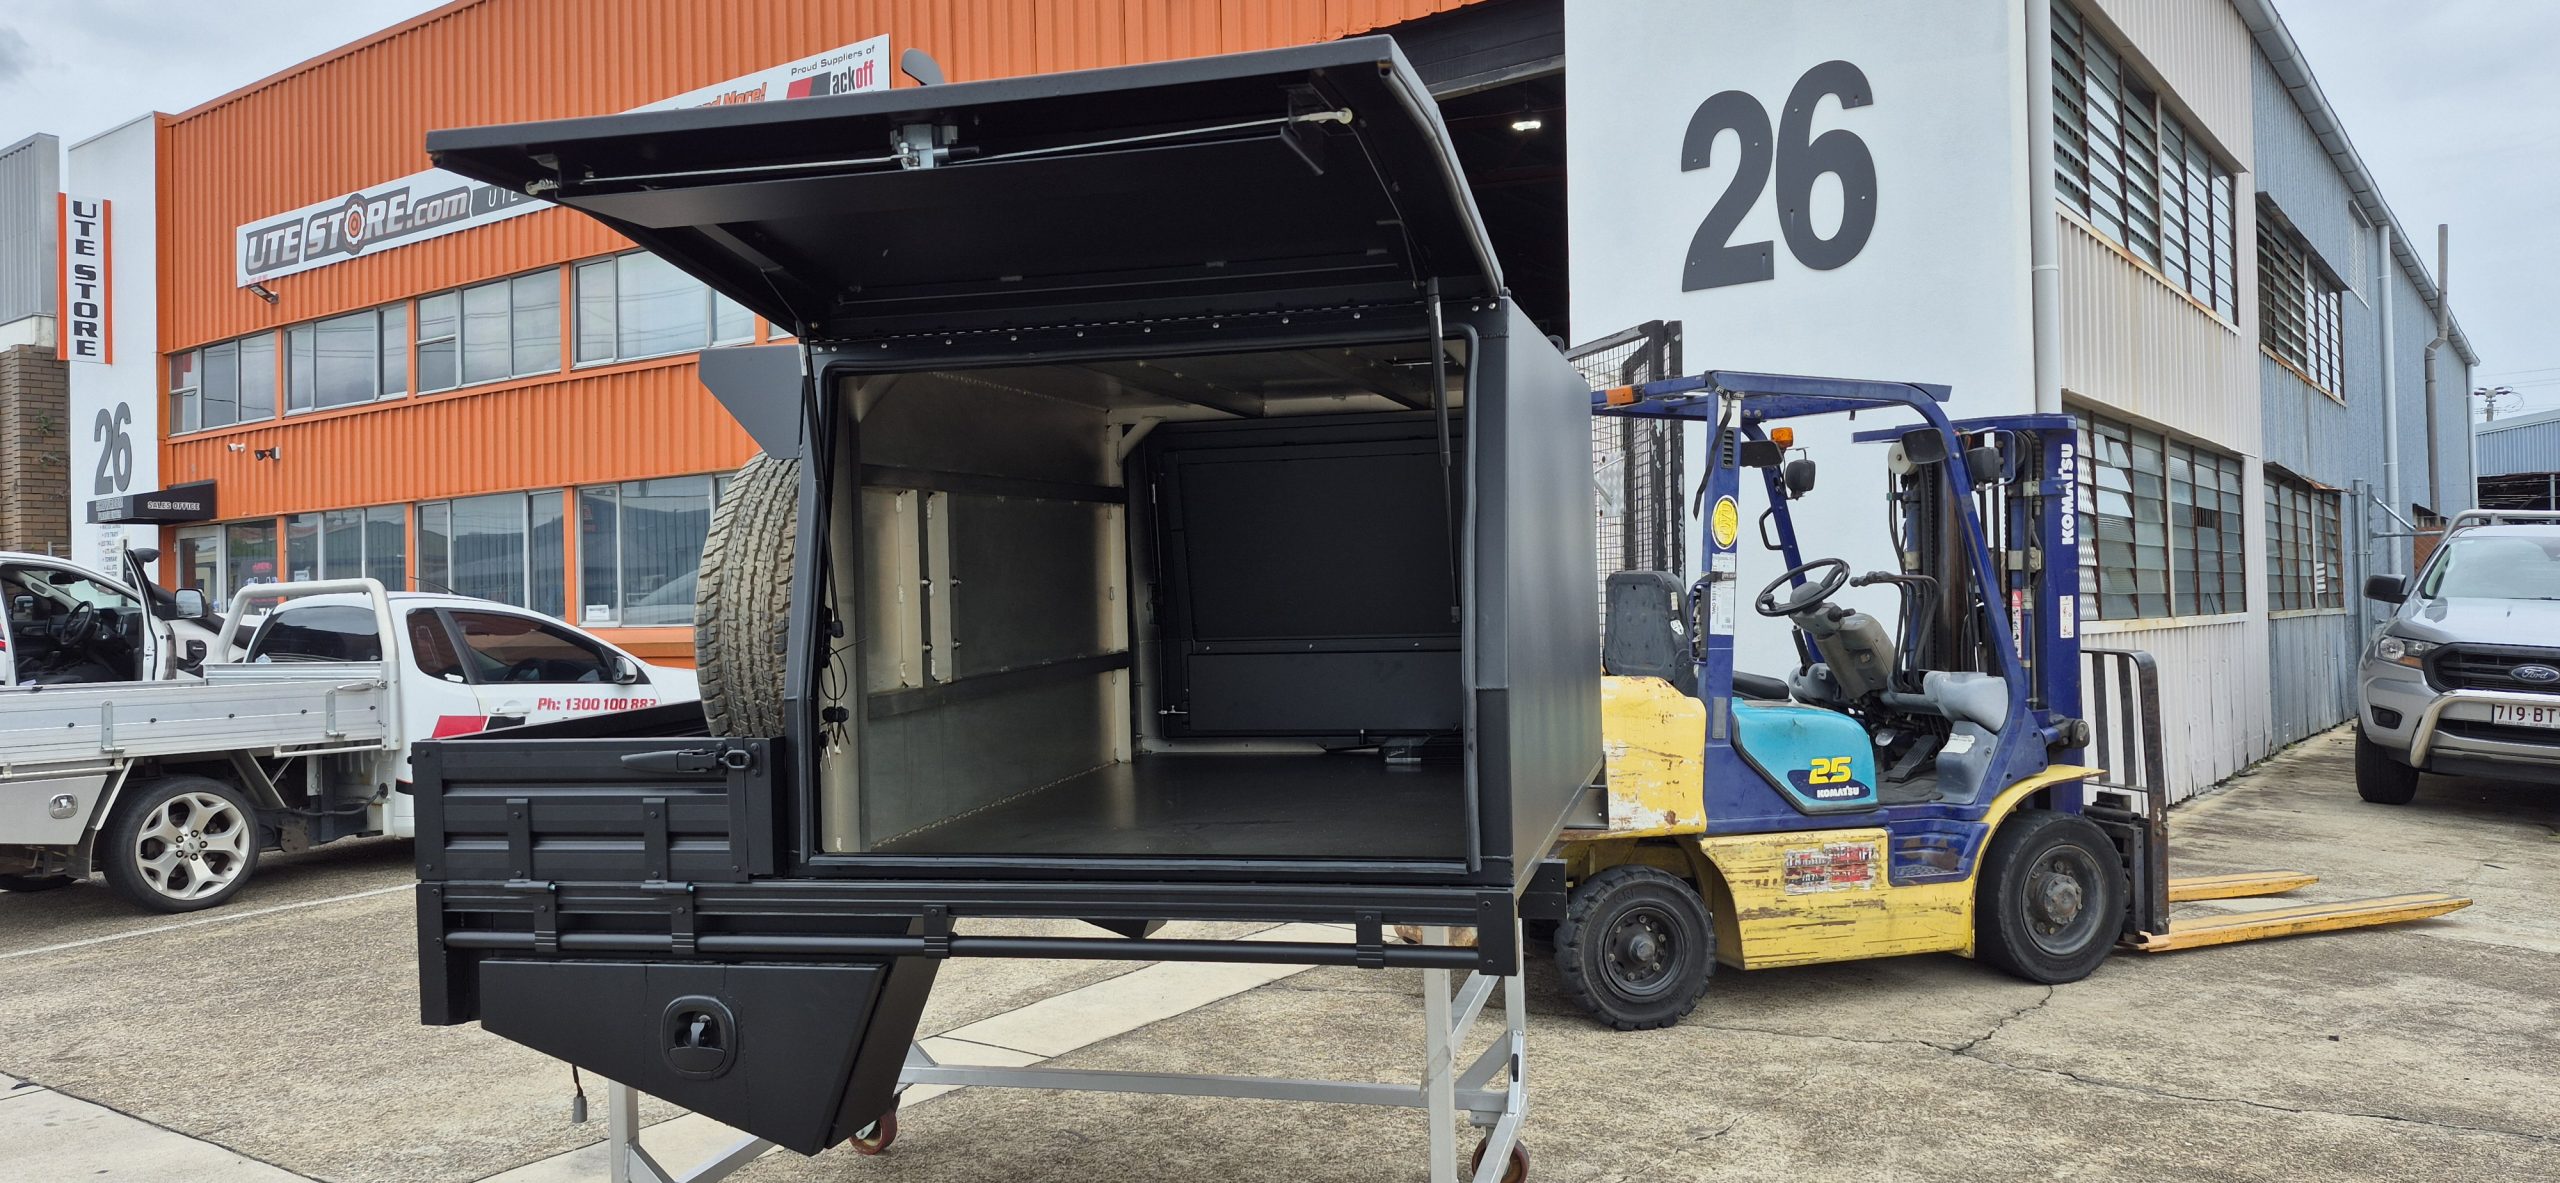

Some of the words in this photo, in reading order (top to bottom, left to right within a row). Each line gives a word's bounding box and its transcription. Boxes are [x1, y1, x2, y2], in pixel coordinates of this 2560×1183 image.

[791, 62, 818, 76] Proud
[821, 50, 863, 67] Suppliers
[866, 44, 875, 55] of
[1681, 60, 1877, 292] 26
[73, 200, 97, 256] UTE
[248, 224, 300, 270] UTE
[74, 264, 98, 356] STORE
[94, 402, 132, 495] 26
[147, 500, 172, 510] SALES
[172, 501, 200, 511] OFFICE
[2058, 443, 2074, 544] KOMATSU
[2521, 668, 2549, 679] Ford
[537, 697, 560, 711] Ph:
[566, 698, 600, 711] 1300
[604, 698, 627, 710] 100
[1809, 756, 1852, 784] 25
[1817, 785, 1859, 798] KOMATSU
